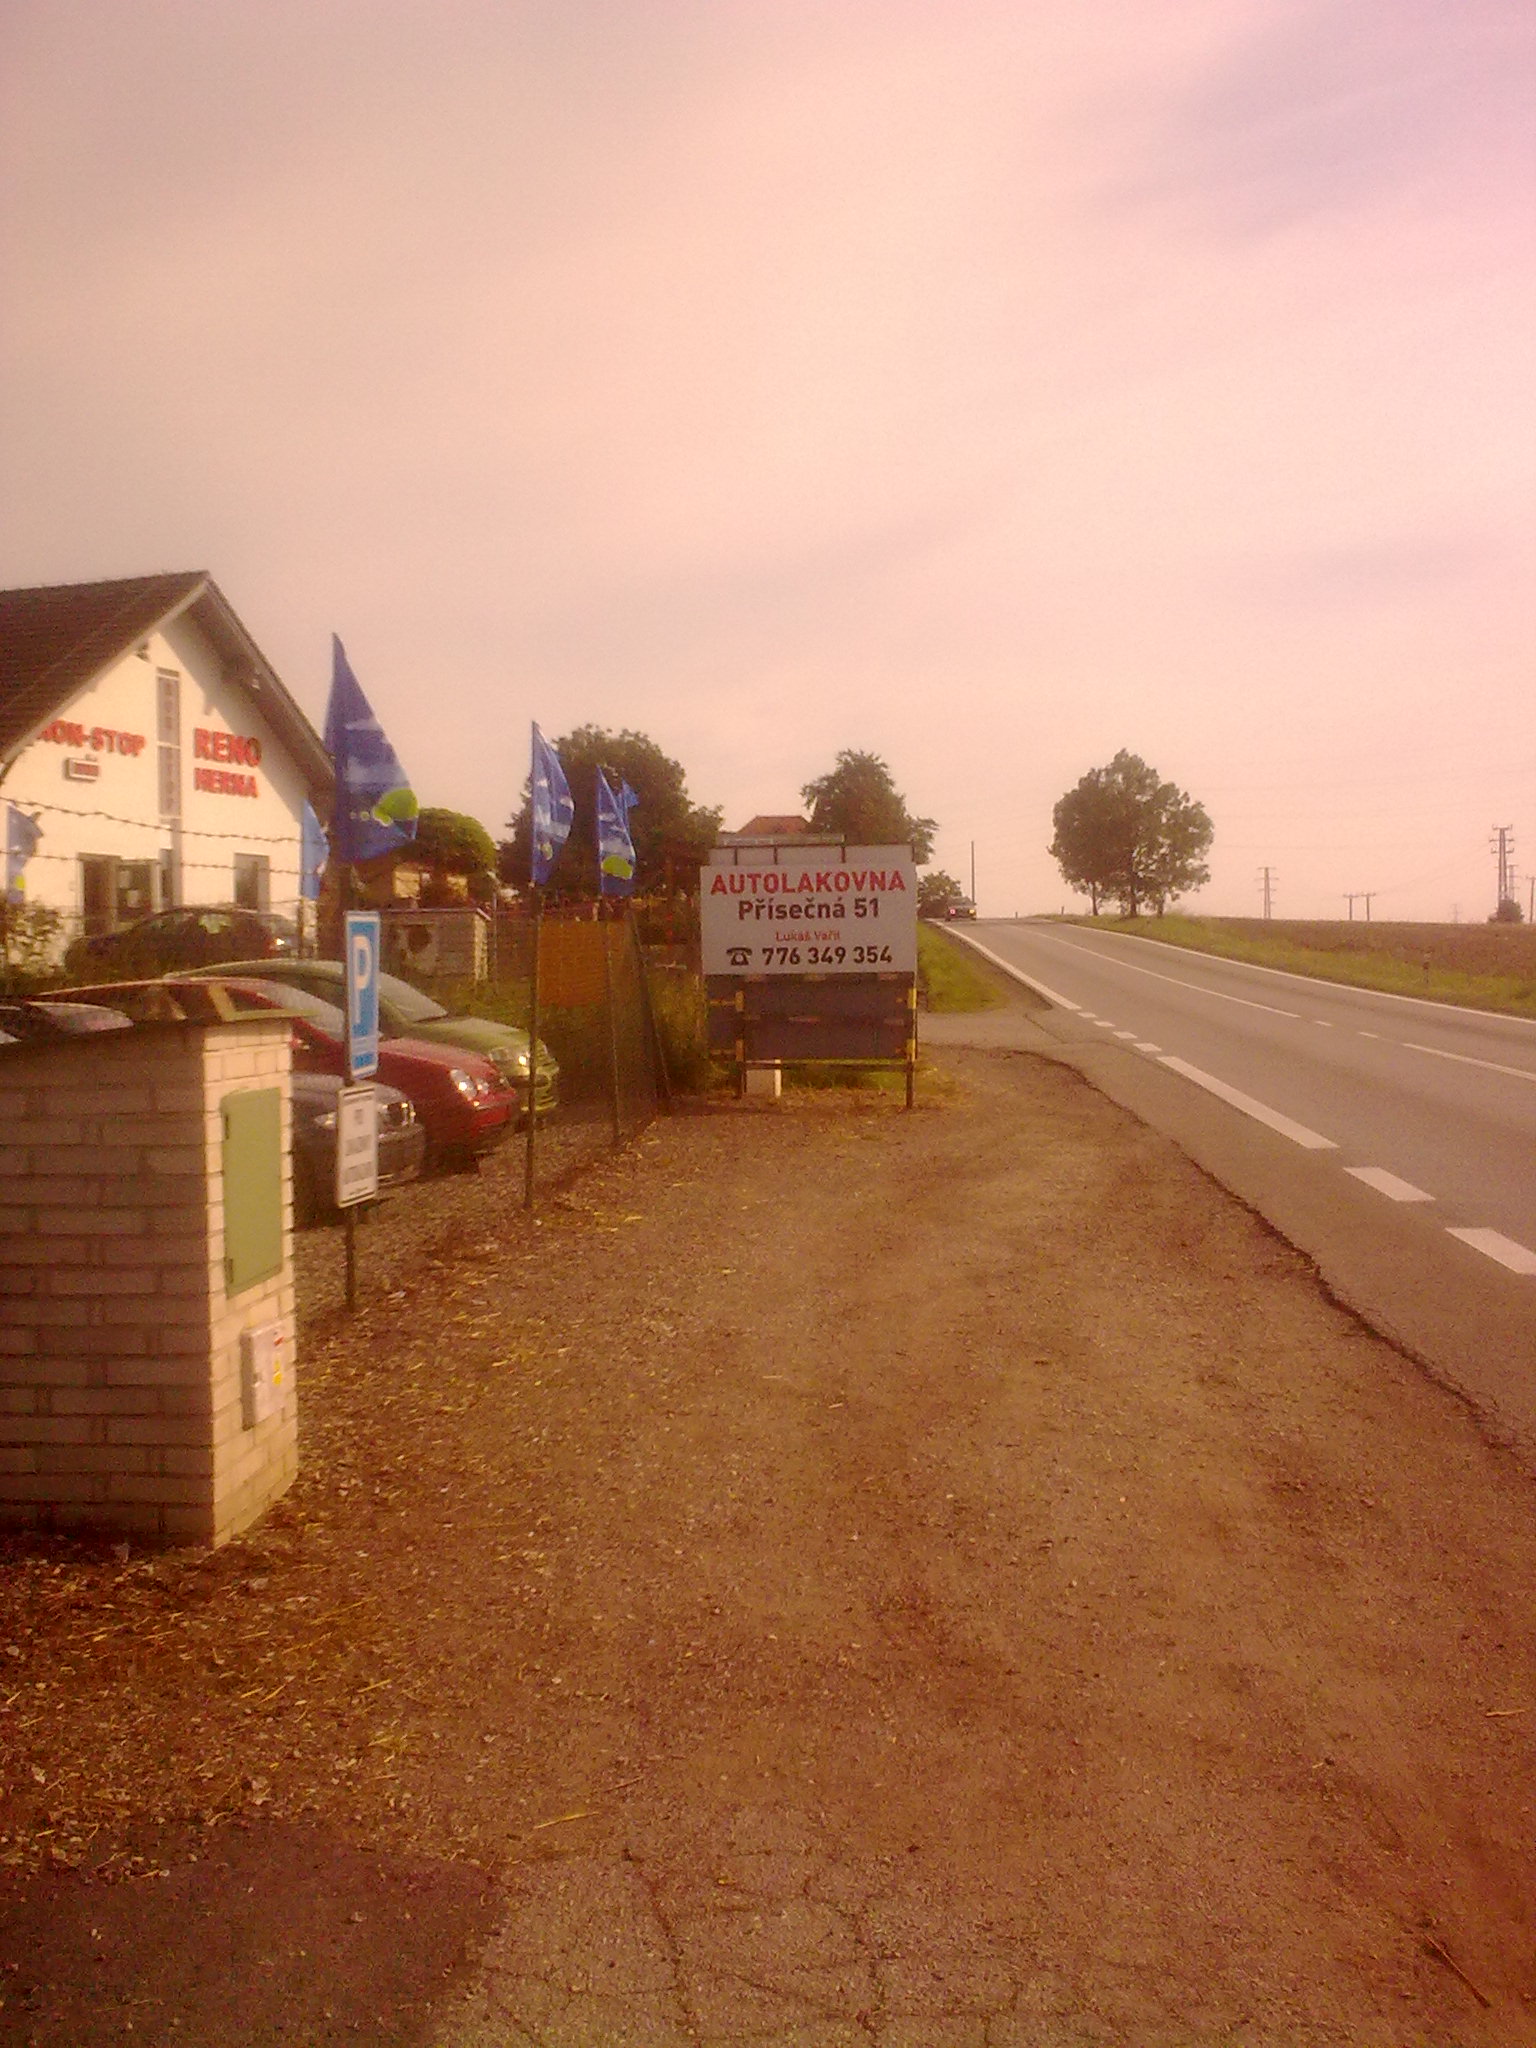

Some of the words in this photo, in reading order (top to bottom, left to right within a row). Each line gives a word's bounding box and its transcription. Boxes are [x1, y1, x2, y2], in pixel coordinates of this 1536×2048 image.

[194, 728, 262, 767] RENO
[710, 869, 906, 896] AUTOLAKOVNA
[738, 896, 846, 920] Přísečná
[854, 898, 879, 918] 51
[762, 947, 801, 966] 776
[807, 946, 847, 965] 349
[853, 945, 893, 964] 354
[353, 935, 372, 1025] P
